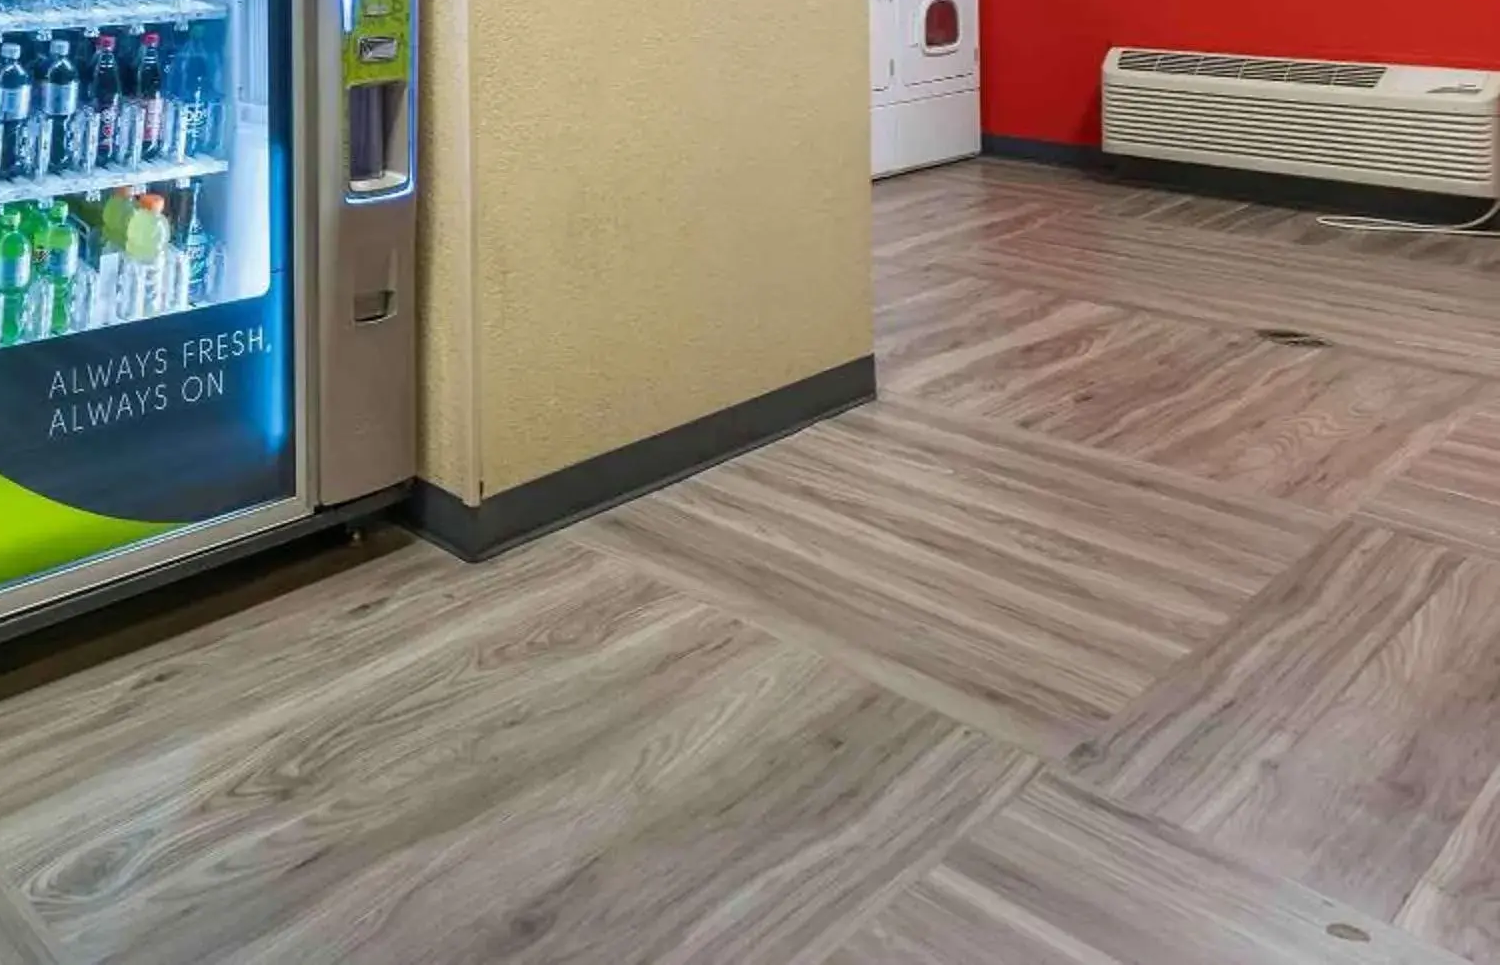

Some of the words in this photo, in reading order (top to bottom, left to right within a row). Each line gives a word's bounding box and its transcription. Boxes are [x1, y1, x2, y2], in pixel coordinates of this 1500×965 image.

[49, 347, 168, 400] ALWAYS
[49, 384, 168, 437] ALWAYS
[181, 370, 224, 402] ON
